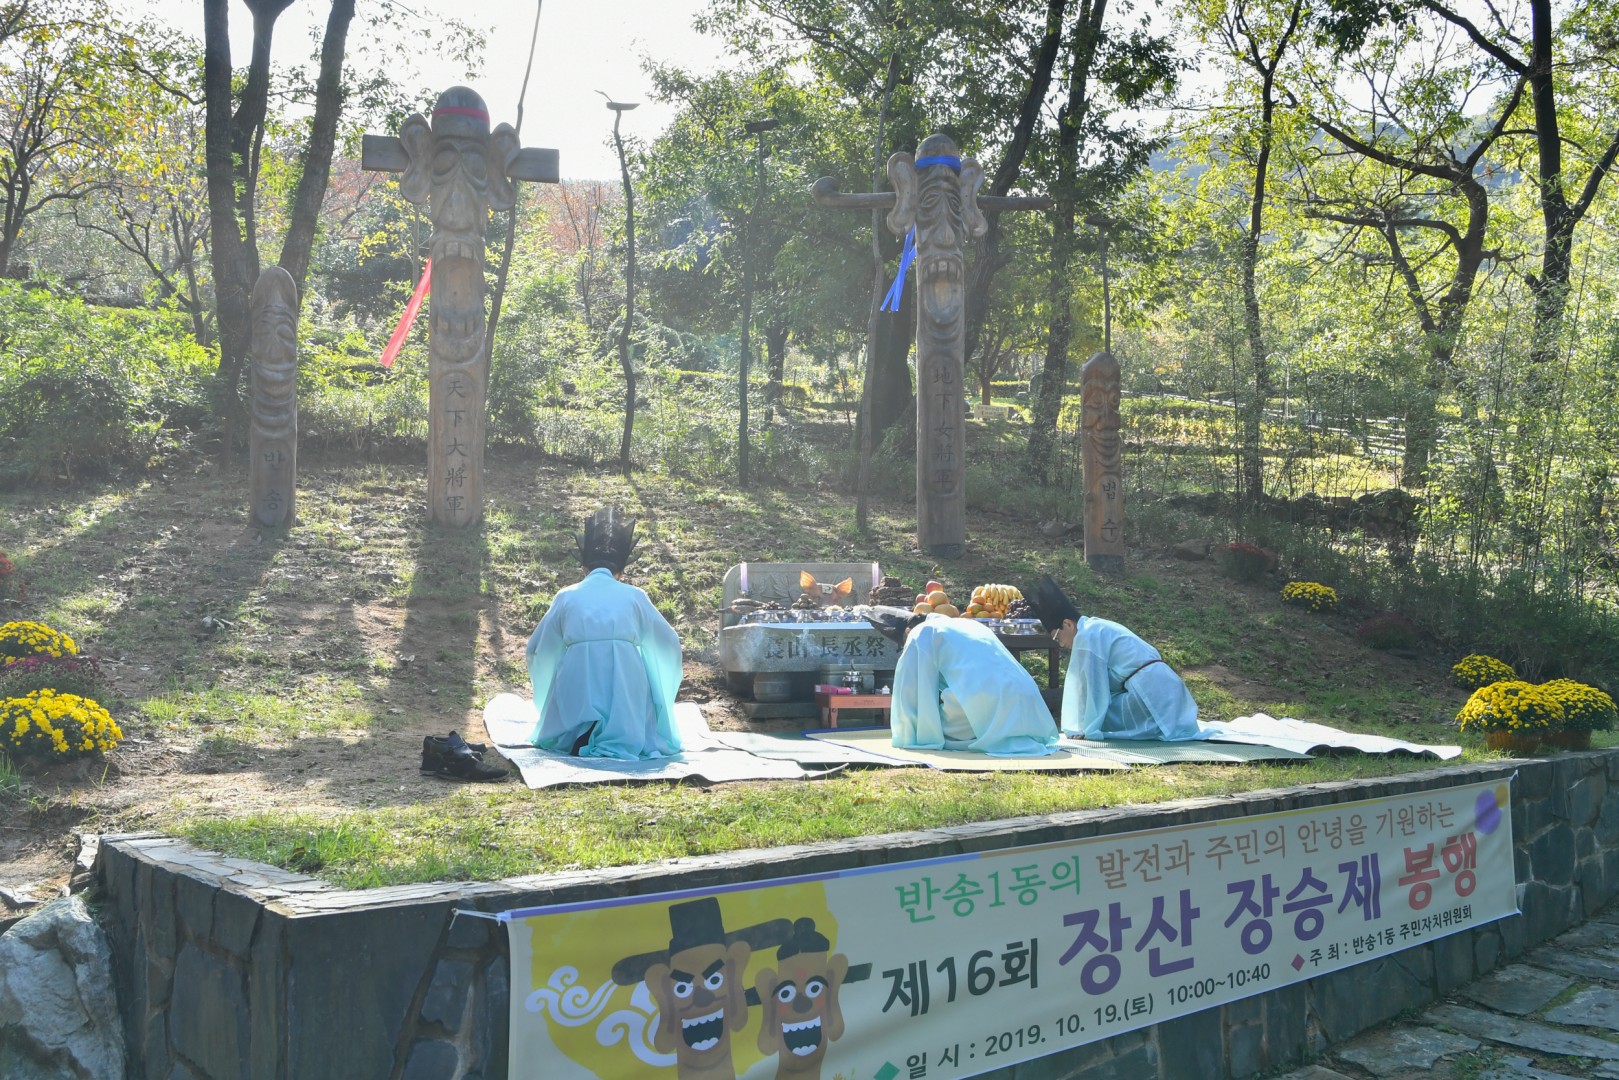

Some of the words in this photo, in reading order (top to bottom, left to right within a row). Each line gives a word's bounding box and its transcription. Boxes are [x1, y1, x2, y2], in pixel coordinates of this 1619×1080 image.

[444, 380, 468, 517] 天下大將軍
[1101, 481, 1118, 537] 법수
[894, 855, 1081, 924] 반송1동의
[1096, 838, 1196, 890] 발전과
[1204, 825, 1287, 871] 주민의
[1296, 813, 1368, 854] 안녕을
[1375, 802, 1455, 839] 기원하는
[881, 938, 1039, 1017] 제16회
[1058, 888, 1201, 996] 장산
[1224, 852, 1381, 955] 장승제
[1398, 831, 1477, 911] 봉행
[1352, 927, 1397, 956] 반송1동
[1399, 904, 1472, 940] 주민자치위원회
[906, 1051, 928, 1080] 일
[984, 1024, 1047, 1057] 2019.
[1055, 1014, 1086, 1037] 10.
[1093, 992, 1154, 1026] 19.(토)
[1167, 963, 1271, 1005] 10:00~10:40
